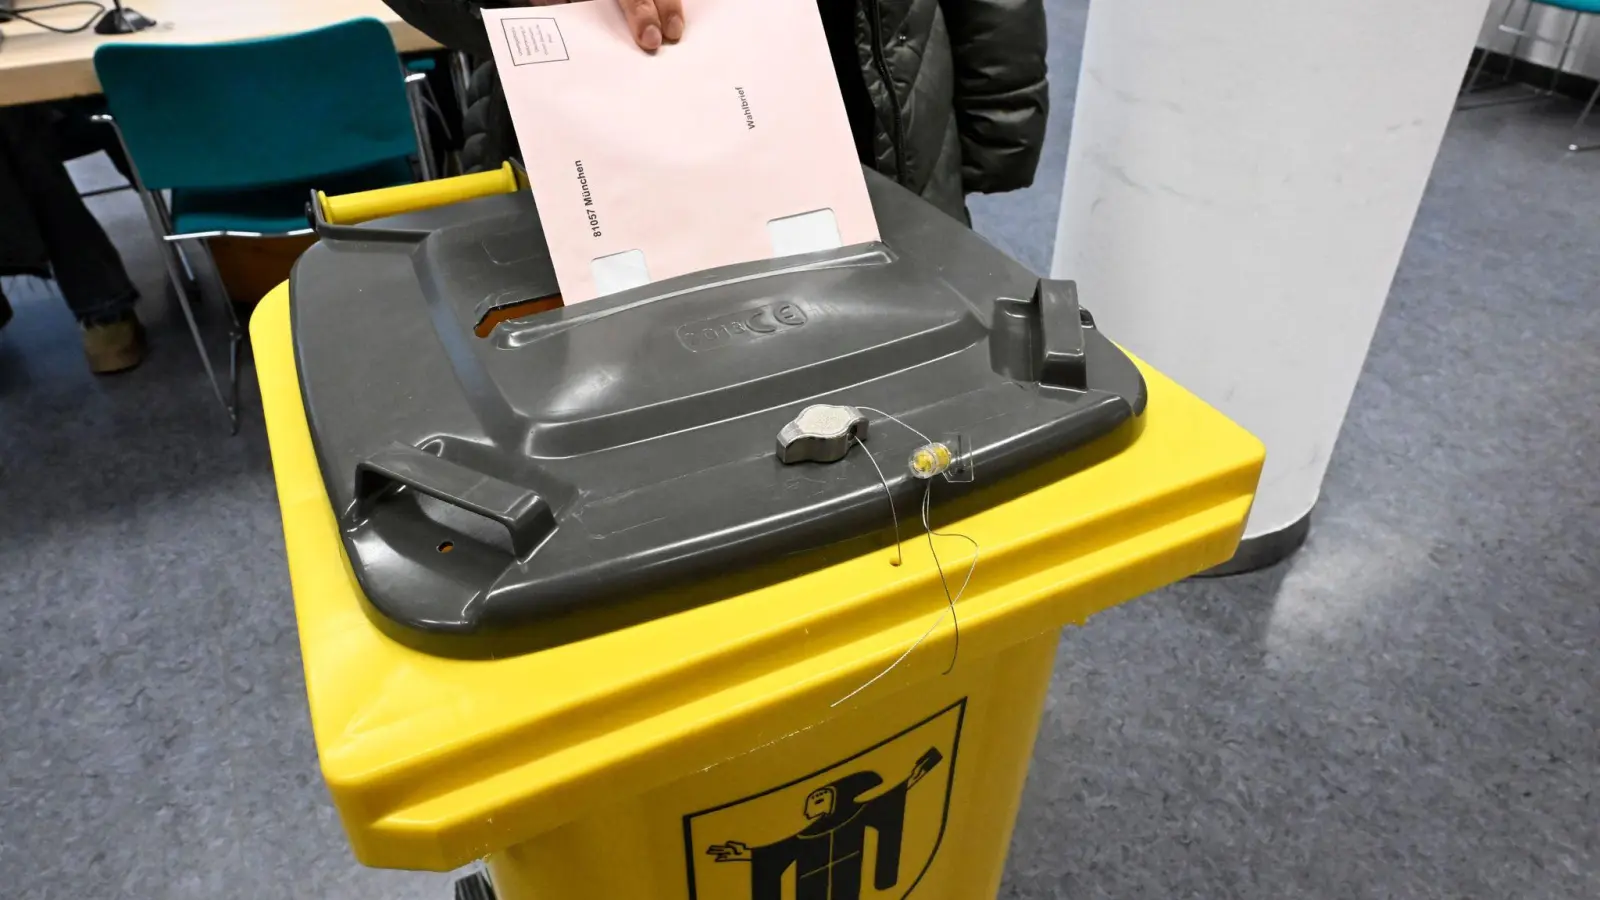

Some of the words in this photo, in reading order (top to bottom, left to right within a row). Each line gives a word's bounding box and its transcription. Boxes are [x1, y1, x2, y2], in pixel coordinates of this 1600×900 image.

[734, 87, 755, 130] Wahlbrief
[574, 160, 593, 206] München
[586, 209, 602, 237] 81057
